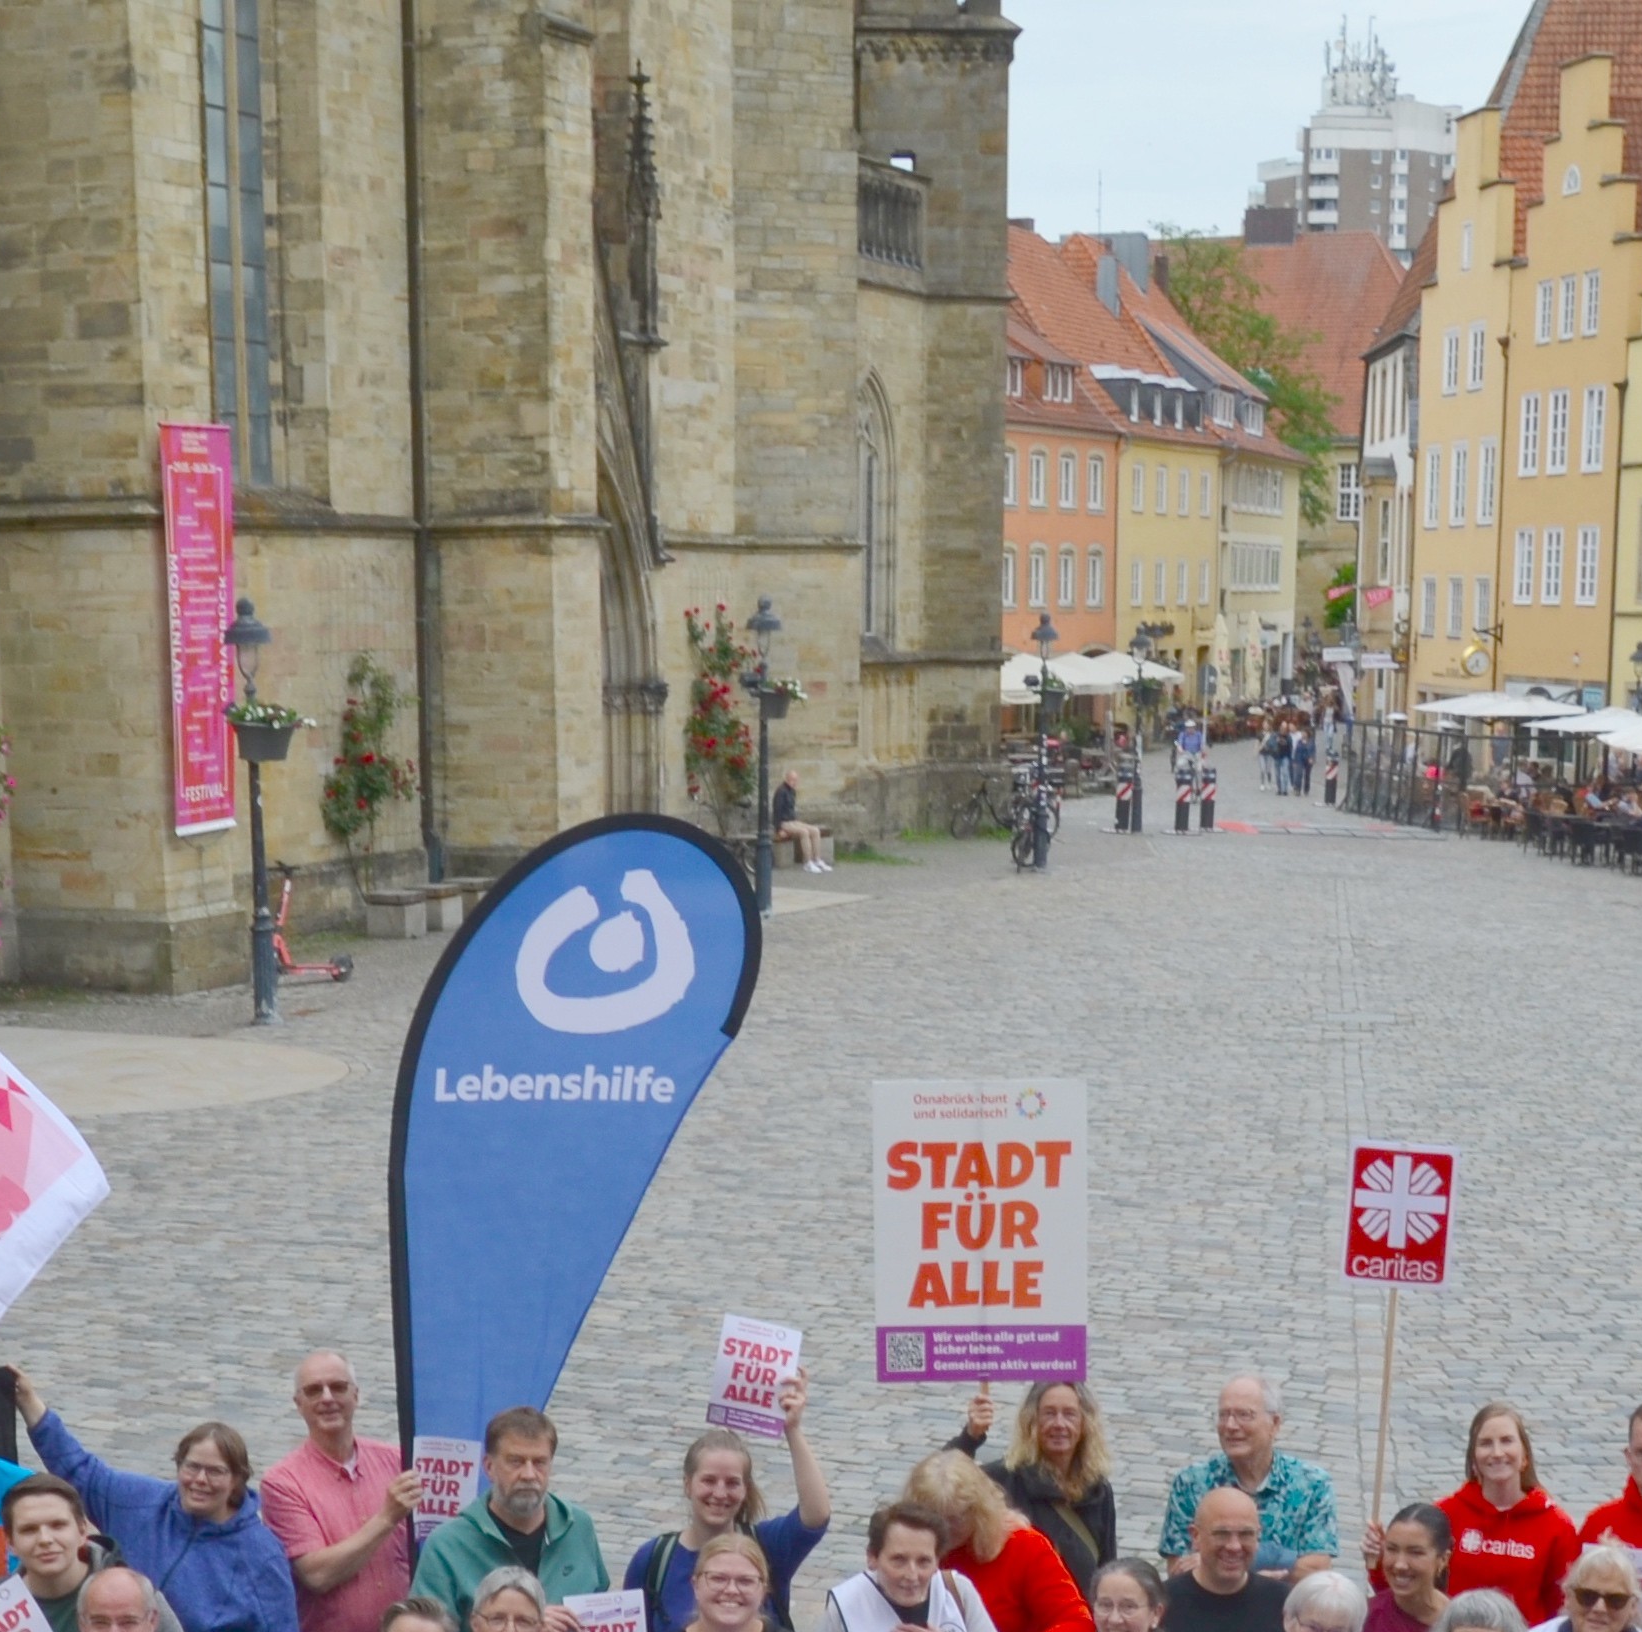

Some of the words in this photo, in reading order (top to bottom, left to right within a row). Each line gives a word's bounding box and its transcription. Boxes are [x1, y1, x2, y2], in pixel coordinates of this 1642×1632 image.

[169, 553, 184, 705] MORGENLAND
[186, 783, 224, 802] FESTIVAL
[434, 1064, 676, 1102] Lebenshilfe
[914, 1108, 936, 1119] und
[939, 1107, 1007, 1120] solidarisch!
[886, 1141, 1072, 1191] STADT
[921, 1191, 1040, 1251] FÜR
[1352, 1253, 1437, 1281] caritas
[908, 1260, 1044, 1309] ALLE
[933, 1331, 952, 1343] Wir
[954, 1331, 992, 1343] wollen
[994, 1331, 1014, 1343] alle
[1016, 1333, 1035, 1346] gut
[1038, 1331, 1059, 1342] und
[934, 1344, 966, 1355] sicher
[969, 1344, 1004, 1355] leben.
[723, 1338, 793, 1366] STADT
[731, 1361, 777, 1386] FÜR
[933, 1360, 998, 1371] Gemeinsam
[1000, 1360, 1028, 1371] aktiv
[1030, 1360, 1077, 1371] werden!
[723, 1384, 776, 1408] ALLE
[1481, 1539, 1535, 1560] caritas
